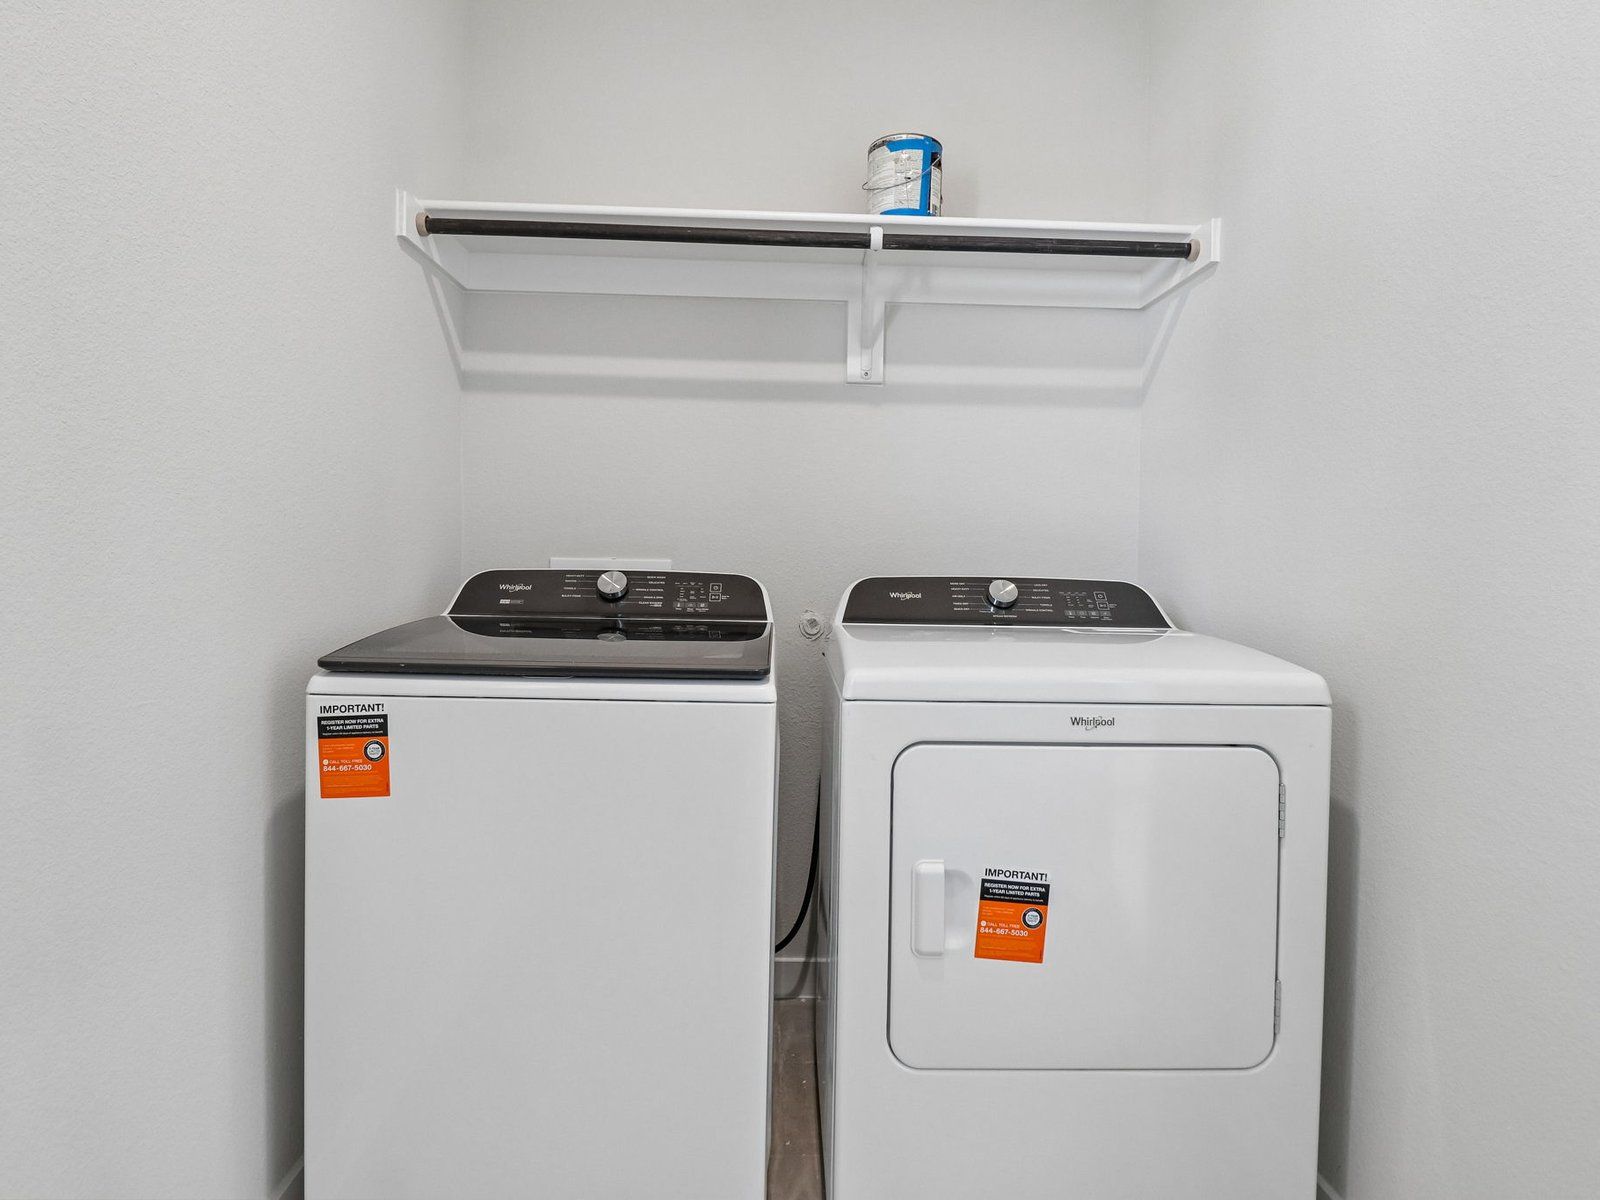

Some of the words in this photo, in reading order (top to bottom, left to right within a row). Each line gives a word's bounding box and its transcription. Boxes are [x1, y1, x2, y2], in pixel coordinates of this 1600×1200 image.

[499, 584, 532, 593] Whirlpool
[889, 591, 922, 601] Whirlpool
[319, 703, 385, 714] IMPORTANT!
[1070, 715, 1115, 731] Whirlpool
[984, 868, 1048, 882] IMPORTANT!
